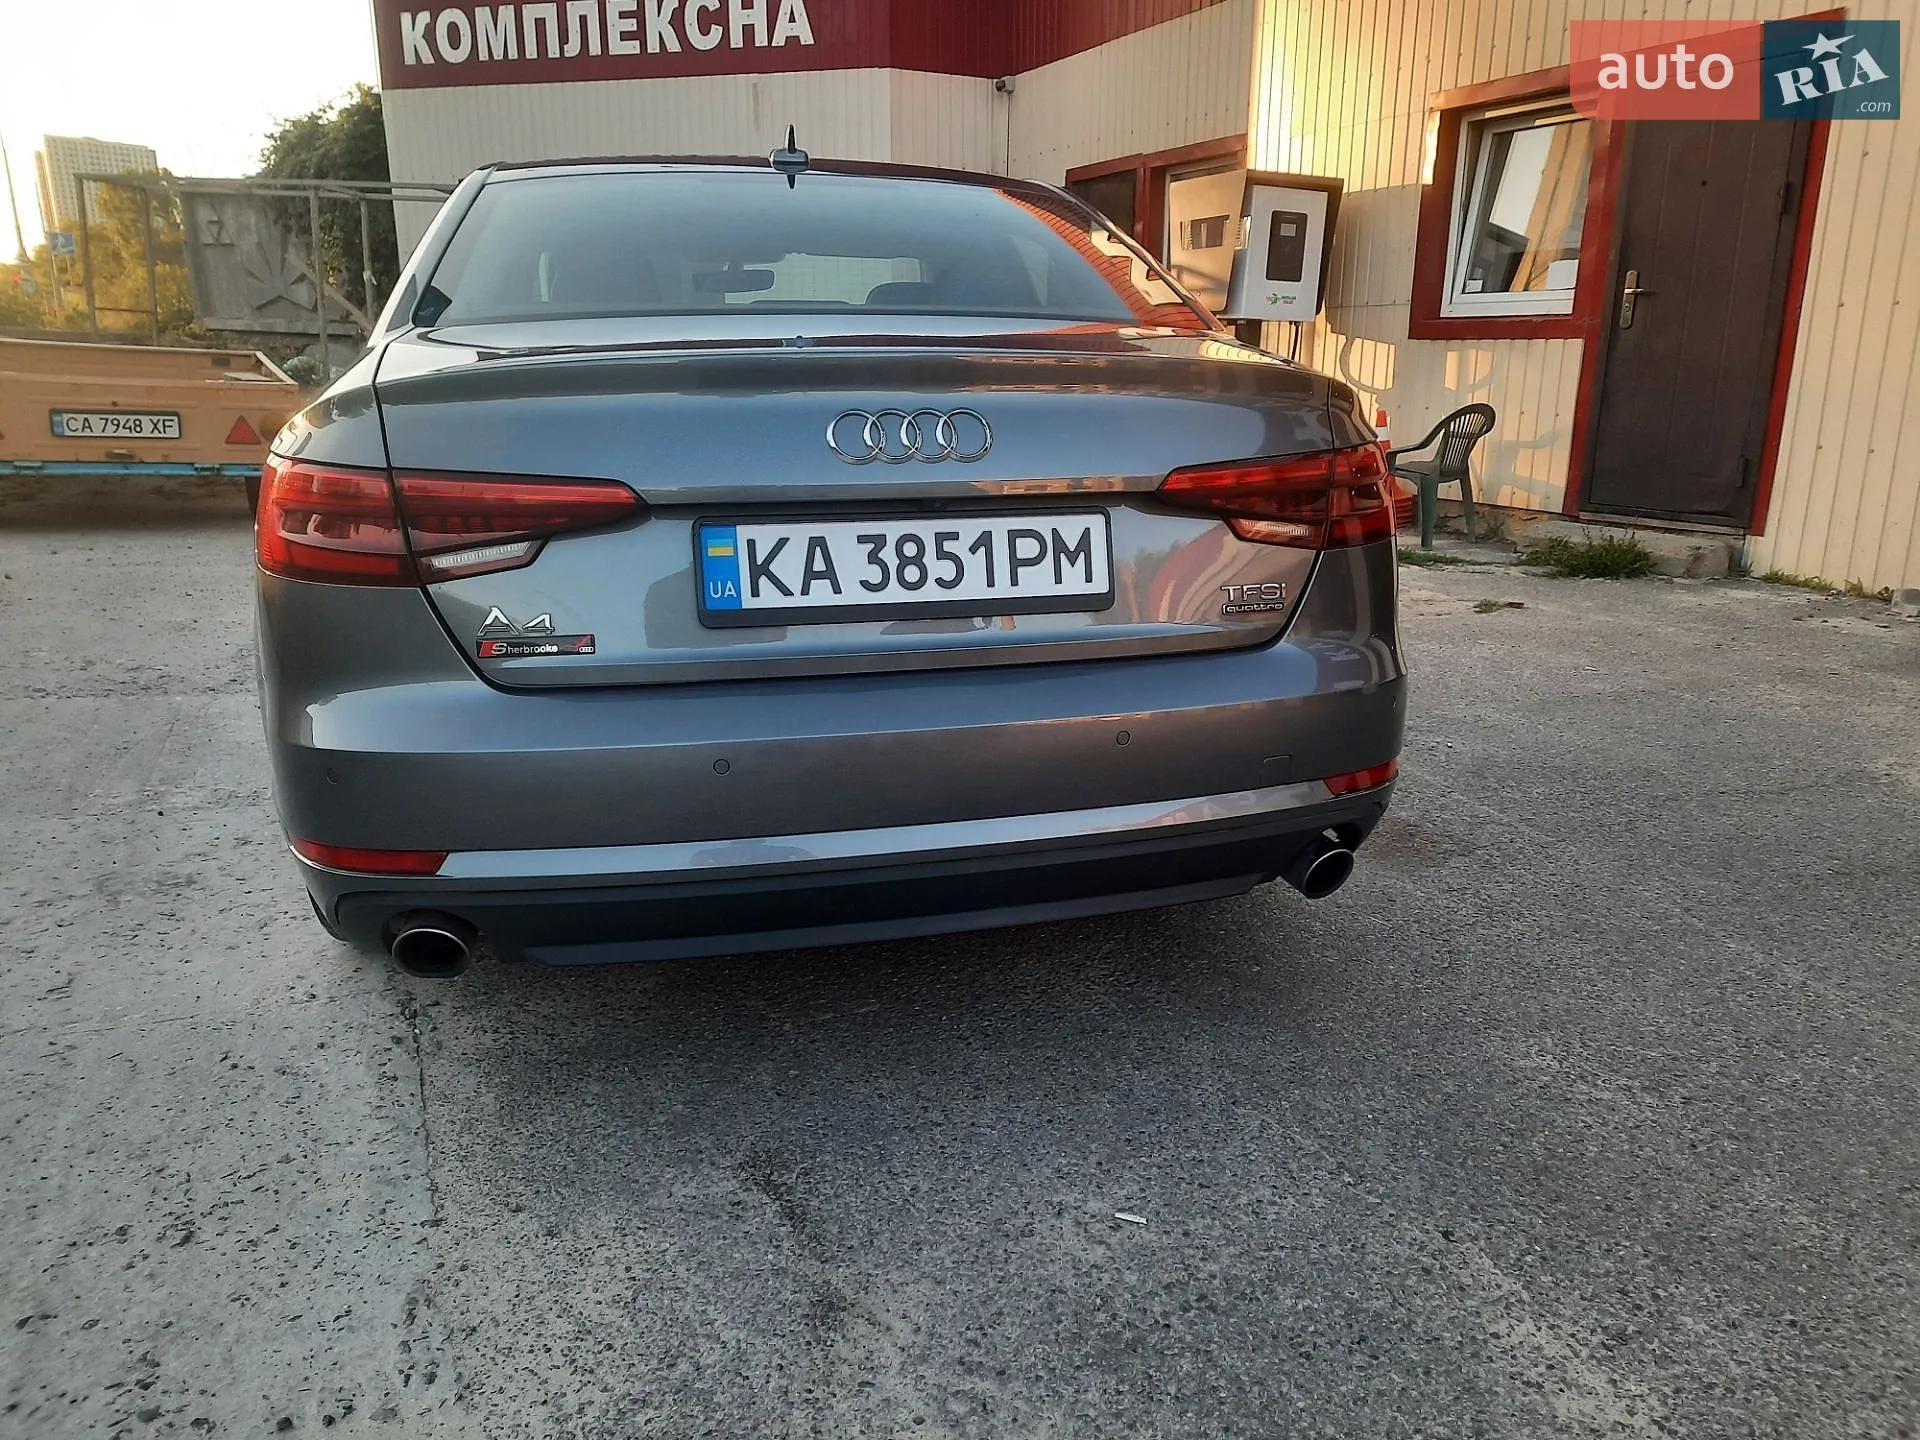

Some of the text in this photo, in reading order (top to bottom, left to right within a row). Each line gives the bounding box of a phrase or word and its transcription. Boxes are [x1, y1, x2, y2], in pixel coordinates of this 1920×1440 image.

[399, 0, 815, 65] КОМПЛЕКСНА
[65, 417, 176, 435] CA 7948 XF
[746, 527, 1093, 598] KA 3851 PM
[709, 580, 737, 598] UA
[1226, 603, 1283, 613] quattro
[477, 606, 556, 636] A4
[491, 642, 559, 655] Sherbrooke
